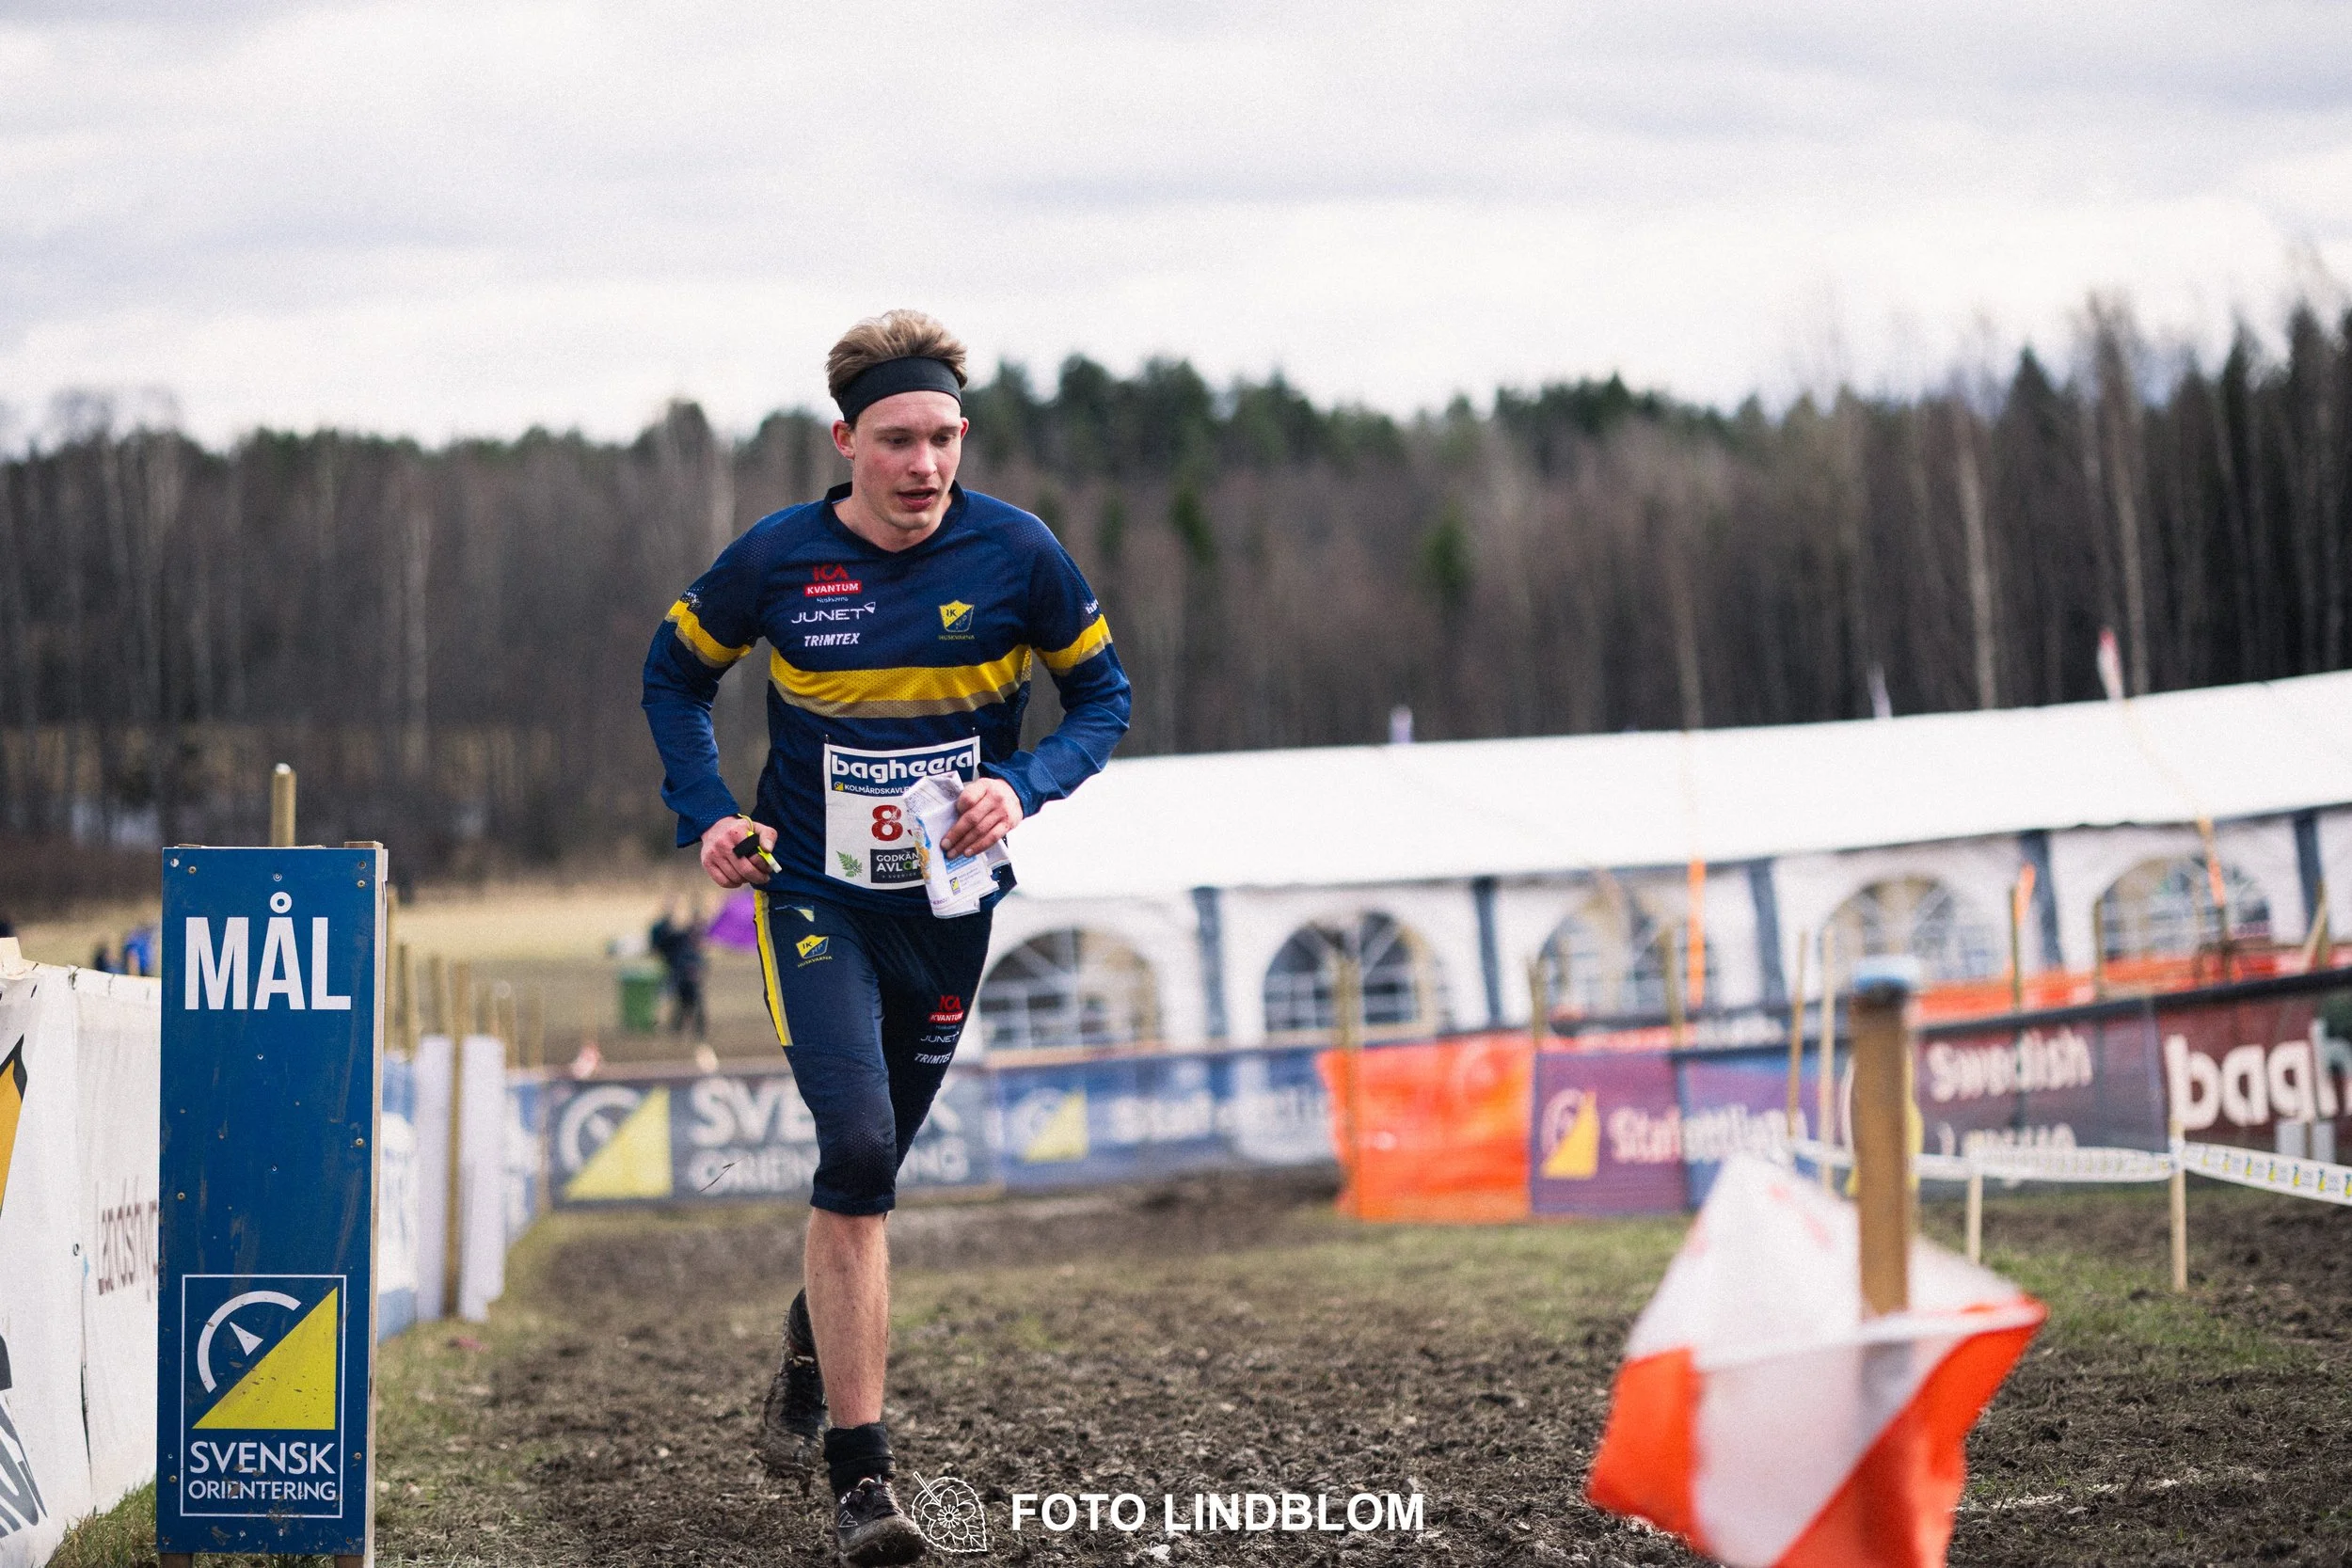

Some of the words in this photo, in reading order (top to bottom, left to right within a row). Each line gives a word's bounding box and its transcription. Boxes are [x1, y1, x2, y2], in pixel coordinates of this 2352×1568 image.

[813, 563, 850, 581] ICA
[807, 583, 859, 594] KVANTUM
[791, 608, 866, 624] JUNET
[946, 609, 958, 617] IK
[804, 632, 860, 647] TRIMTEX
[832, 751, 973, 784] bagheera
[844, 784, 912, 795] KOLMÅRDSKAVLE
[871, 804, 914, 842] 8
[184, 892, 351, 1010] MÅL
[939, 994, 961, 1011] ICA
[1927, 1027, 2093, 1102] Swedish
[190, 1441, 336, 1475] SVENSK
[188, 1481, 337, 1501] ORIENTERING
